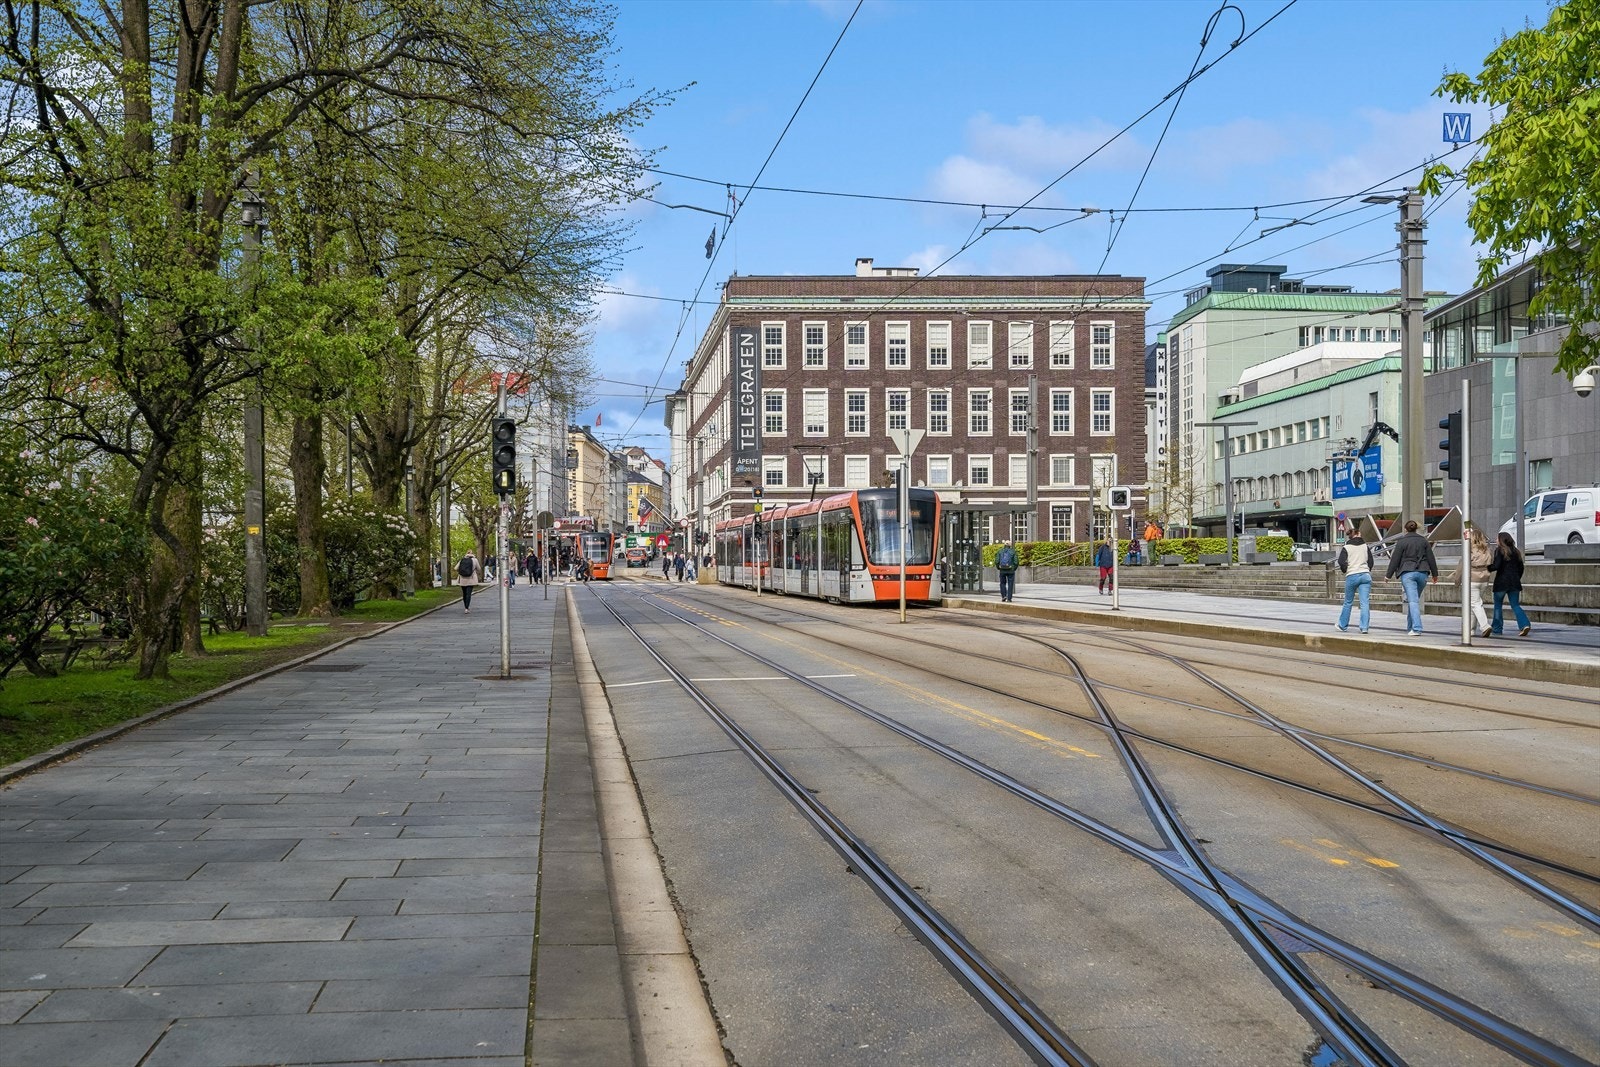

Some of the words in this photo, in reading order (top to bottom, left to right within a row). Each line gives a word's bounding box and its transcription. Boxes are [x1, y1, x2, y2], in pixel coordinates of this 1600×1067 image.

[1444, 116, 1470, 140] W
[740, 334, 754, 450] TELEGRAFEN
[736, 456, 758, 464] ÅPENT
